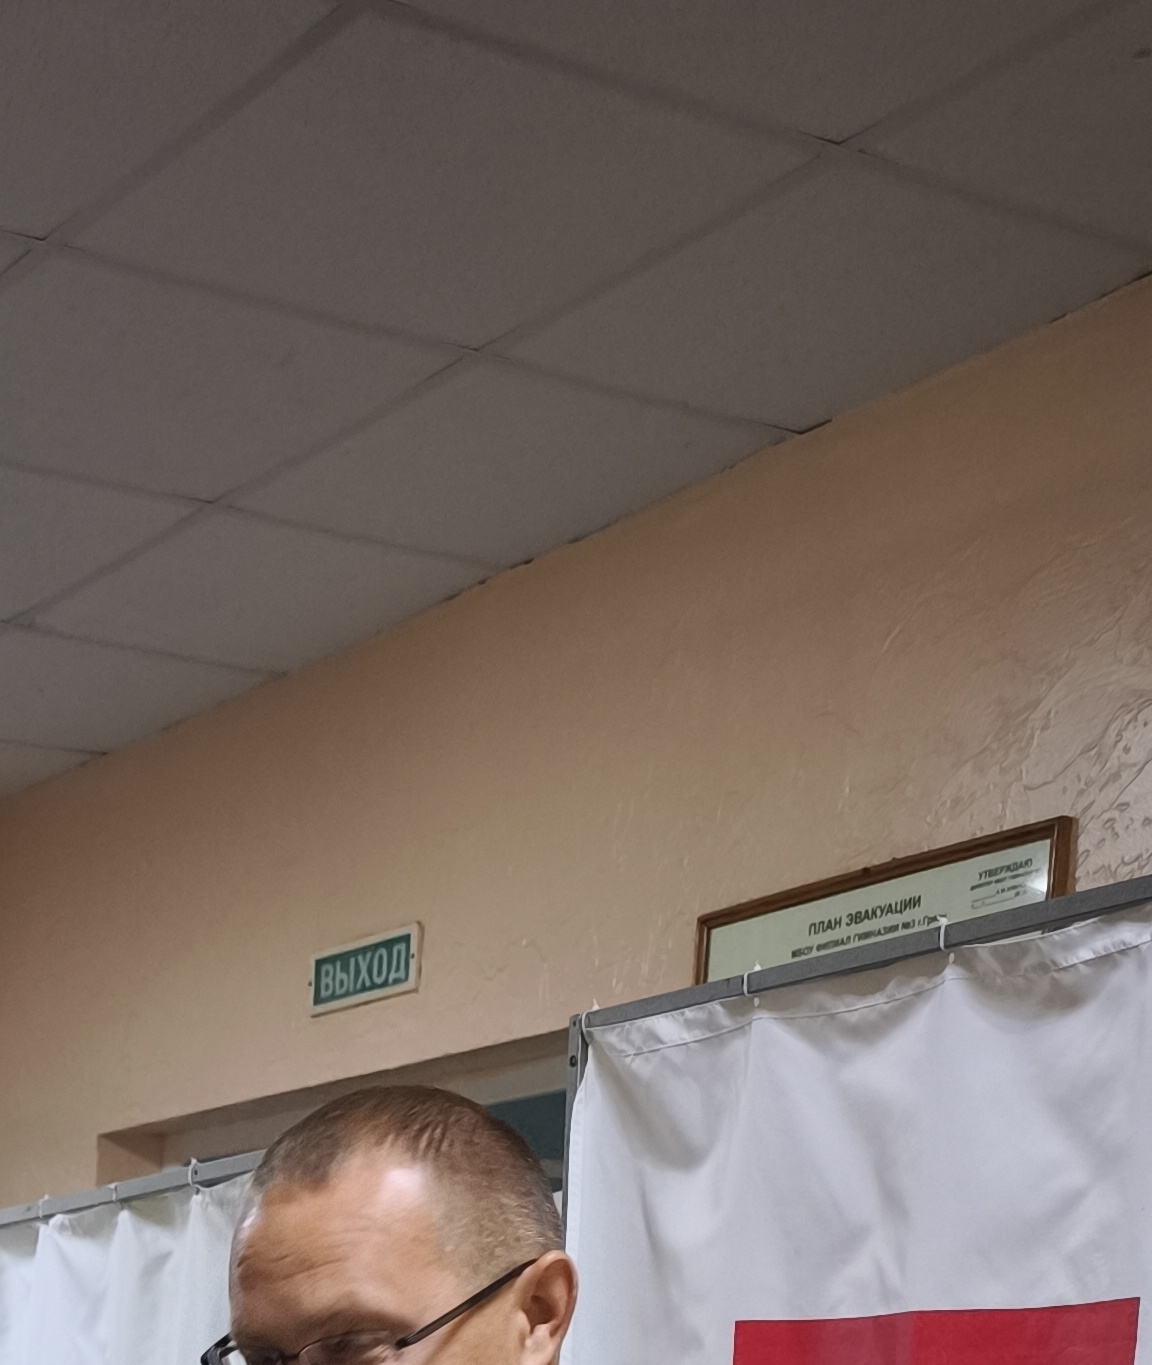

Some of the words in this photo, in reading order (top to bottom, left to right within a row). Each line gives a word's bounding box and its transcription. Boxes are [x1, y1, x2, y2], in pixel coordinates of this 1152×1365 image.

[808, 916, 842, 936] ПЛАН
[845, 895, 921, 927] ЭВАКУАЦИИ
[320, 942, 406, 998] ВЫХОД
